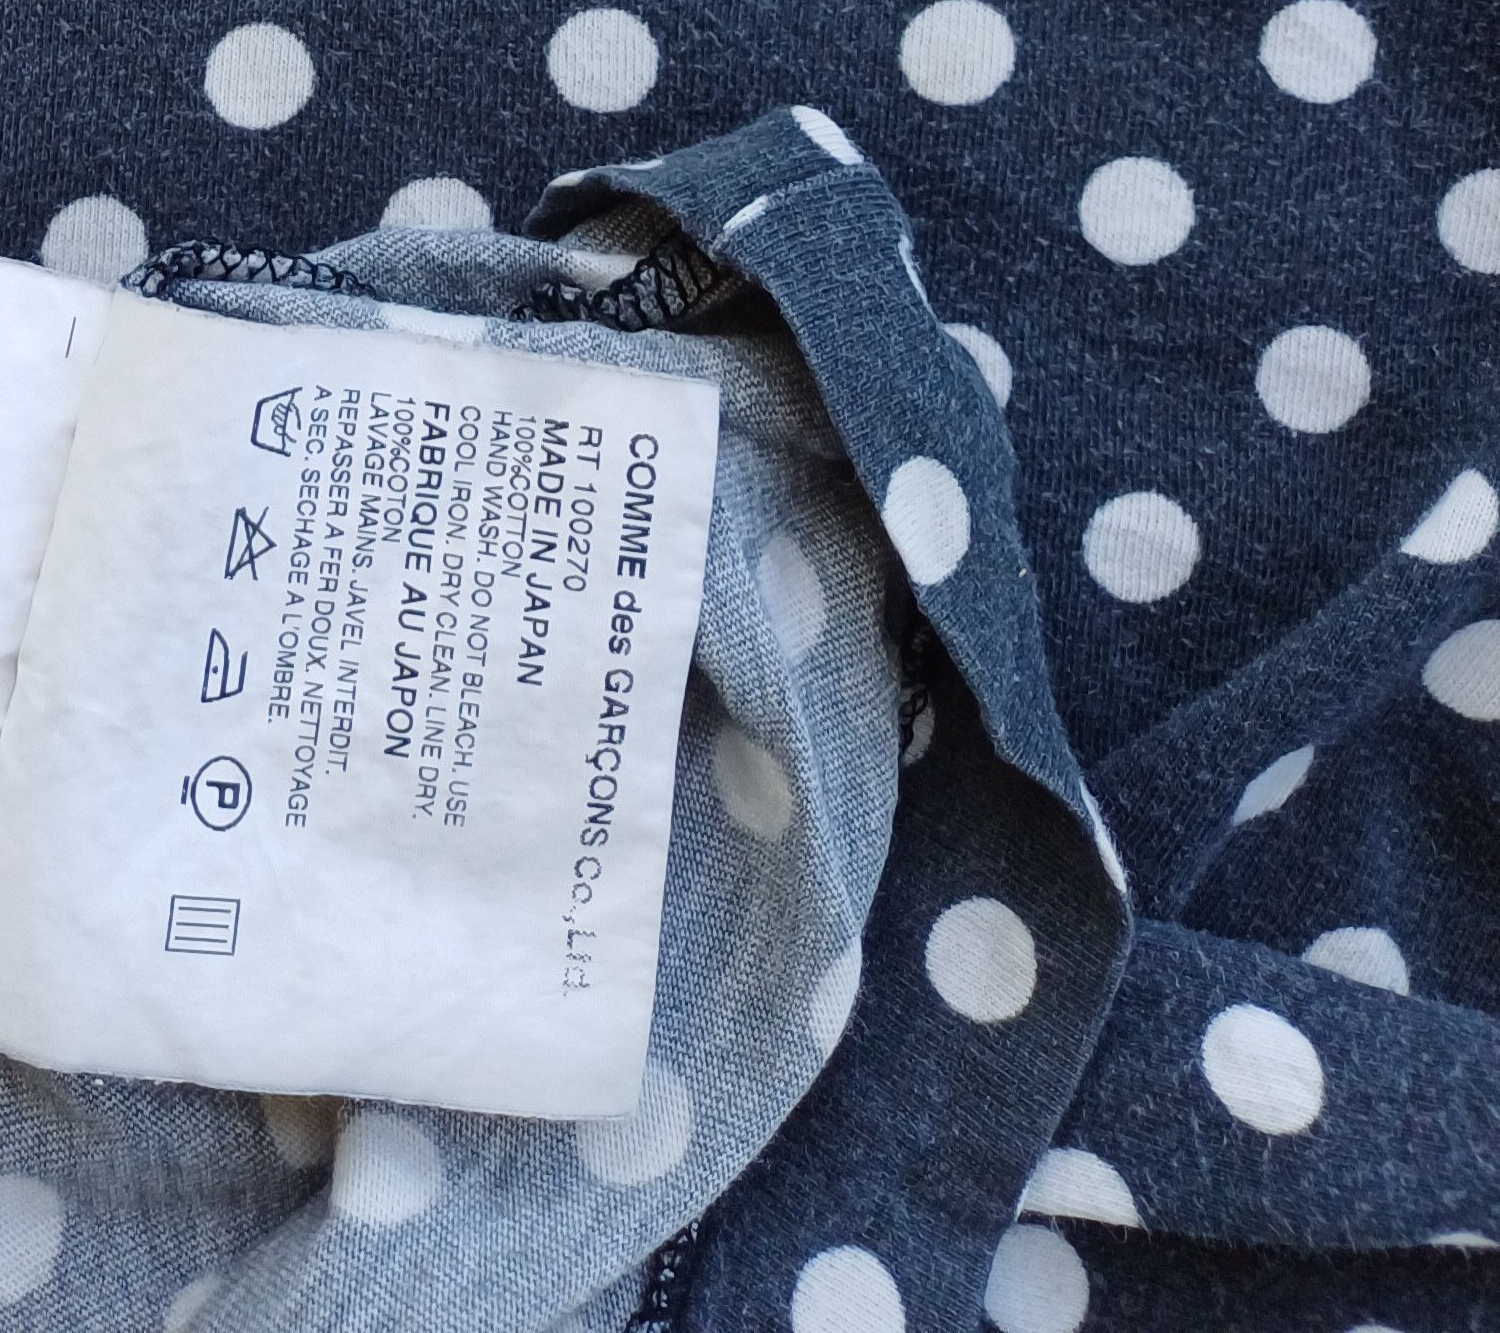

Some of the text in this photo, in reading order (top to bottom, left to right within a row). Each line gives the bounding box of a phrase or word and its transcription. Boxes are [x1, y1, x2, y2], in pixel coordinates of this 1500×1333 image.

[266, 383, 333, 724] A SEC. SECHAGE A L'OMBRE.
[324, 390, 393, 775] LAVAGE MAINS. JAVEL INTERDIT.
[379, 395, 417, 544] 100%COTON
[382, 399, 451, 759] FABRIQUE AU JAPON
[499, 414, 537, 579] 100%COTTON
[515, 416, 570, 687] MADE IN JAPAN
[561, 424, 603, 593] RT 100270
[615, 432, 660, 580] COMME
[283, 387, 361, 828] REPASSER A FER DOUX. NETTOYAGE
[411, 404, 482, 819] COOL IRON. DRY CLEAN. LINE DRY.
[442, 409, 513, 828] HAND WASH. DO NOT BLEACH. USE
[606, 588, 643, 657] des
[578, 667, 634, 847] GARÇONS
